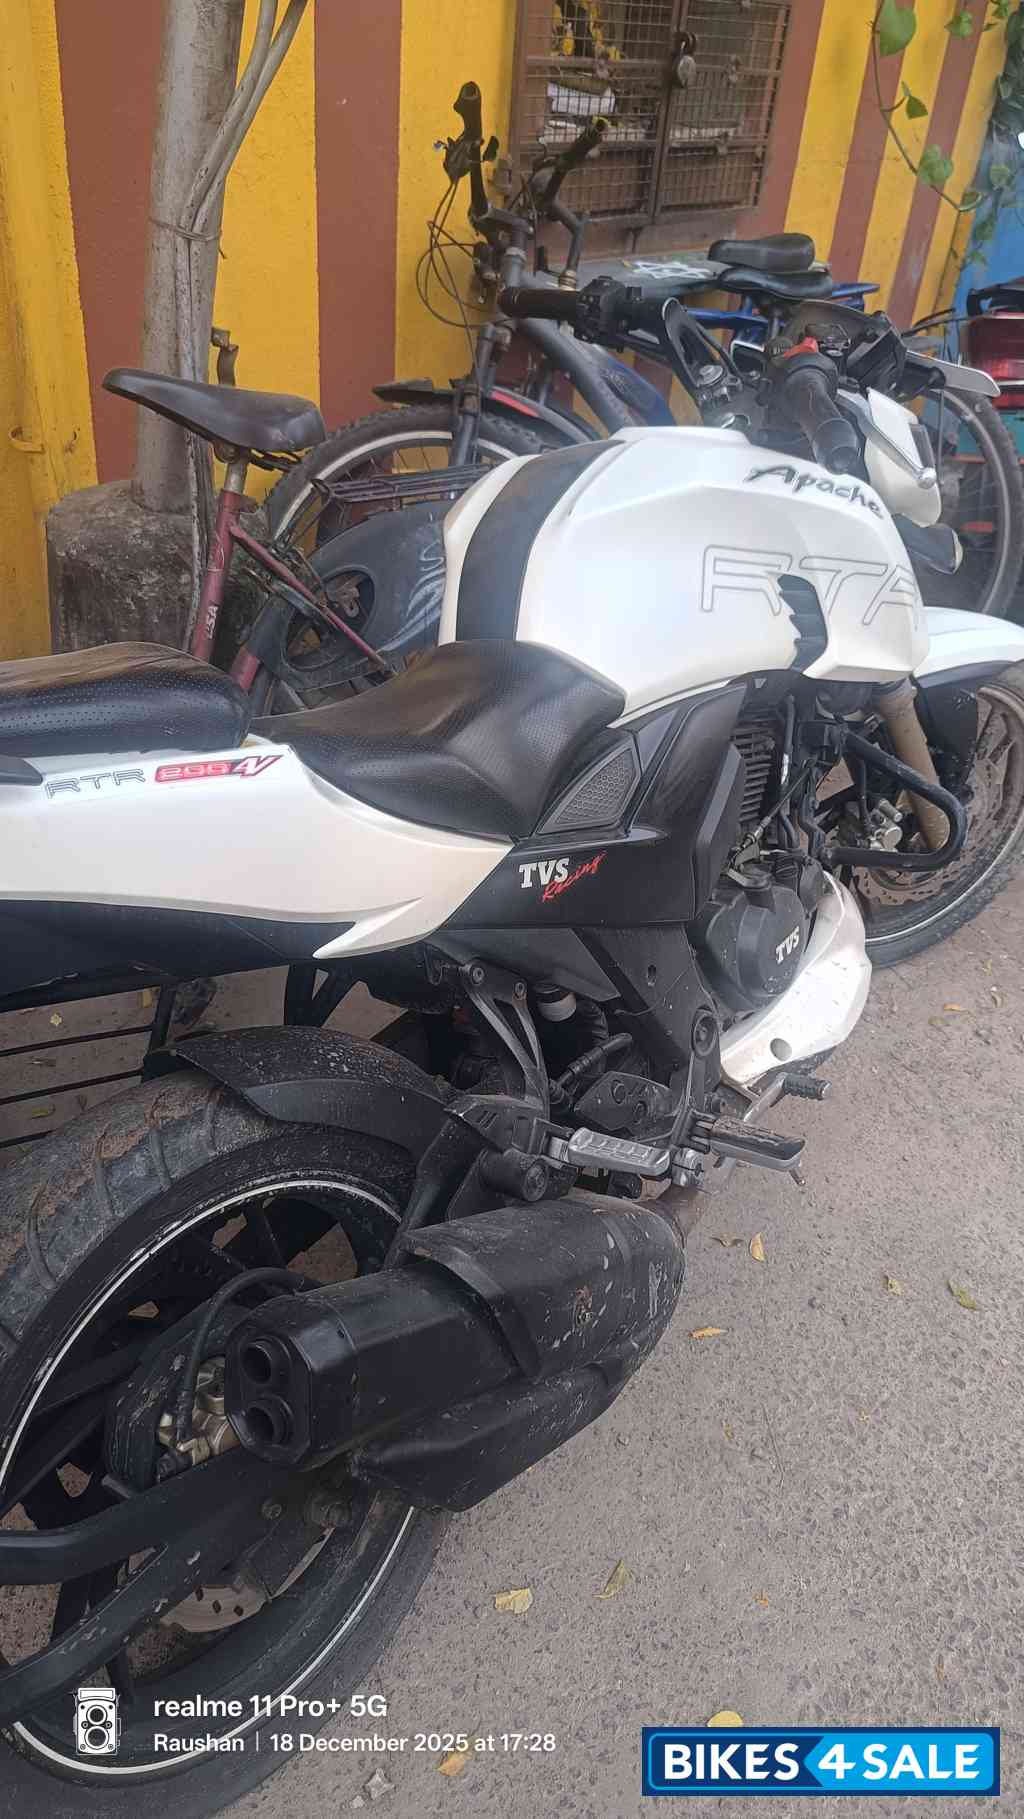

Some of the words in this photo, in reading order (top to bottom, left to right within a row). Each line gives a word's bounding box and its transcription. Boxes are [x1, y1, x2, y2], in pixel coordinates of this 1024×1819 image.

[743, 464, 884, 519] Apache
[44, 767, 146, 800] RTR
[518, 857, 570, 889] TVS
[541, 850, 608, 904] Racing
[775, 925, 800, 965] TVS
